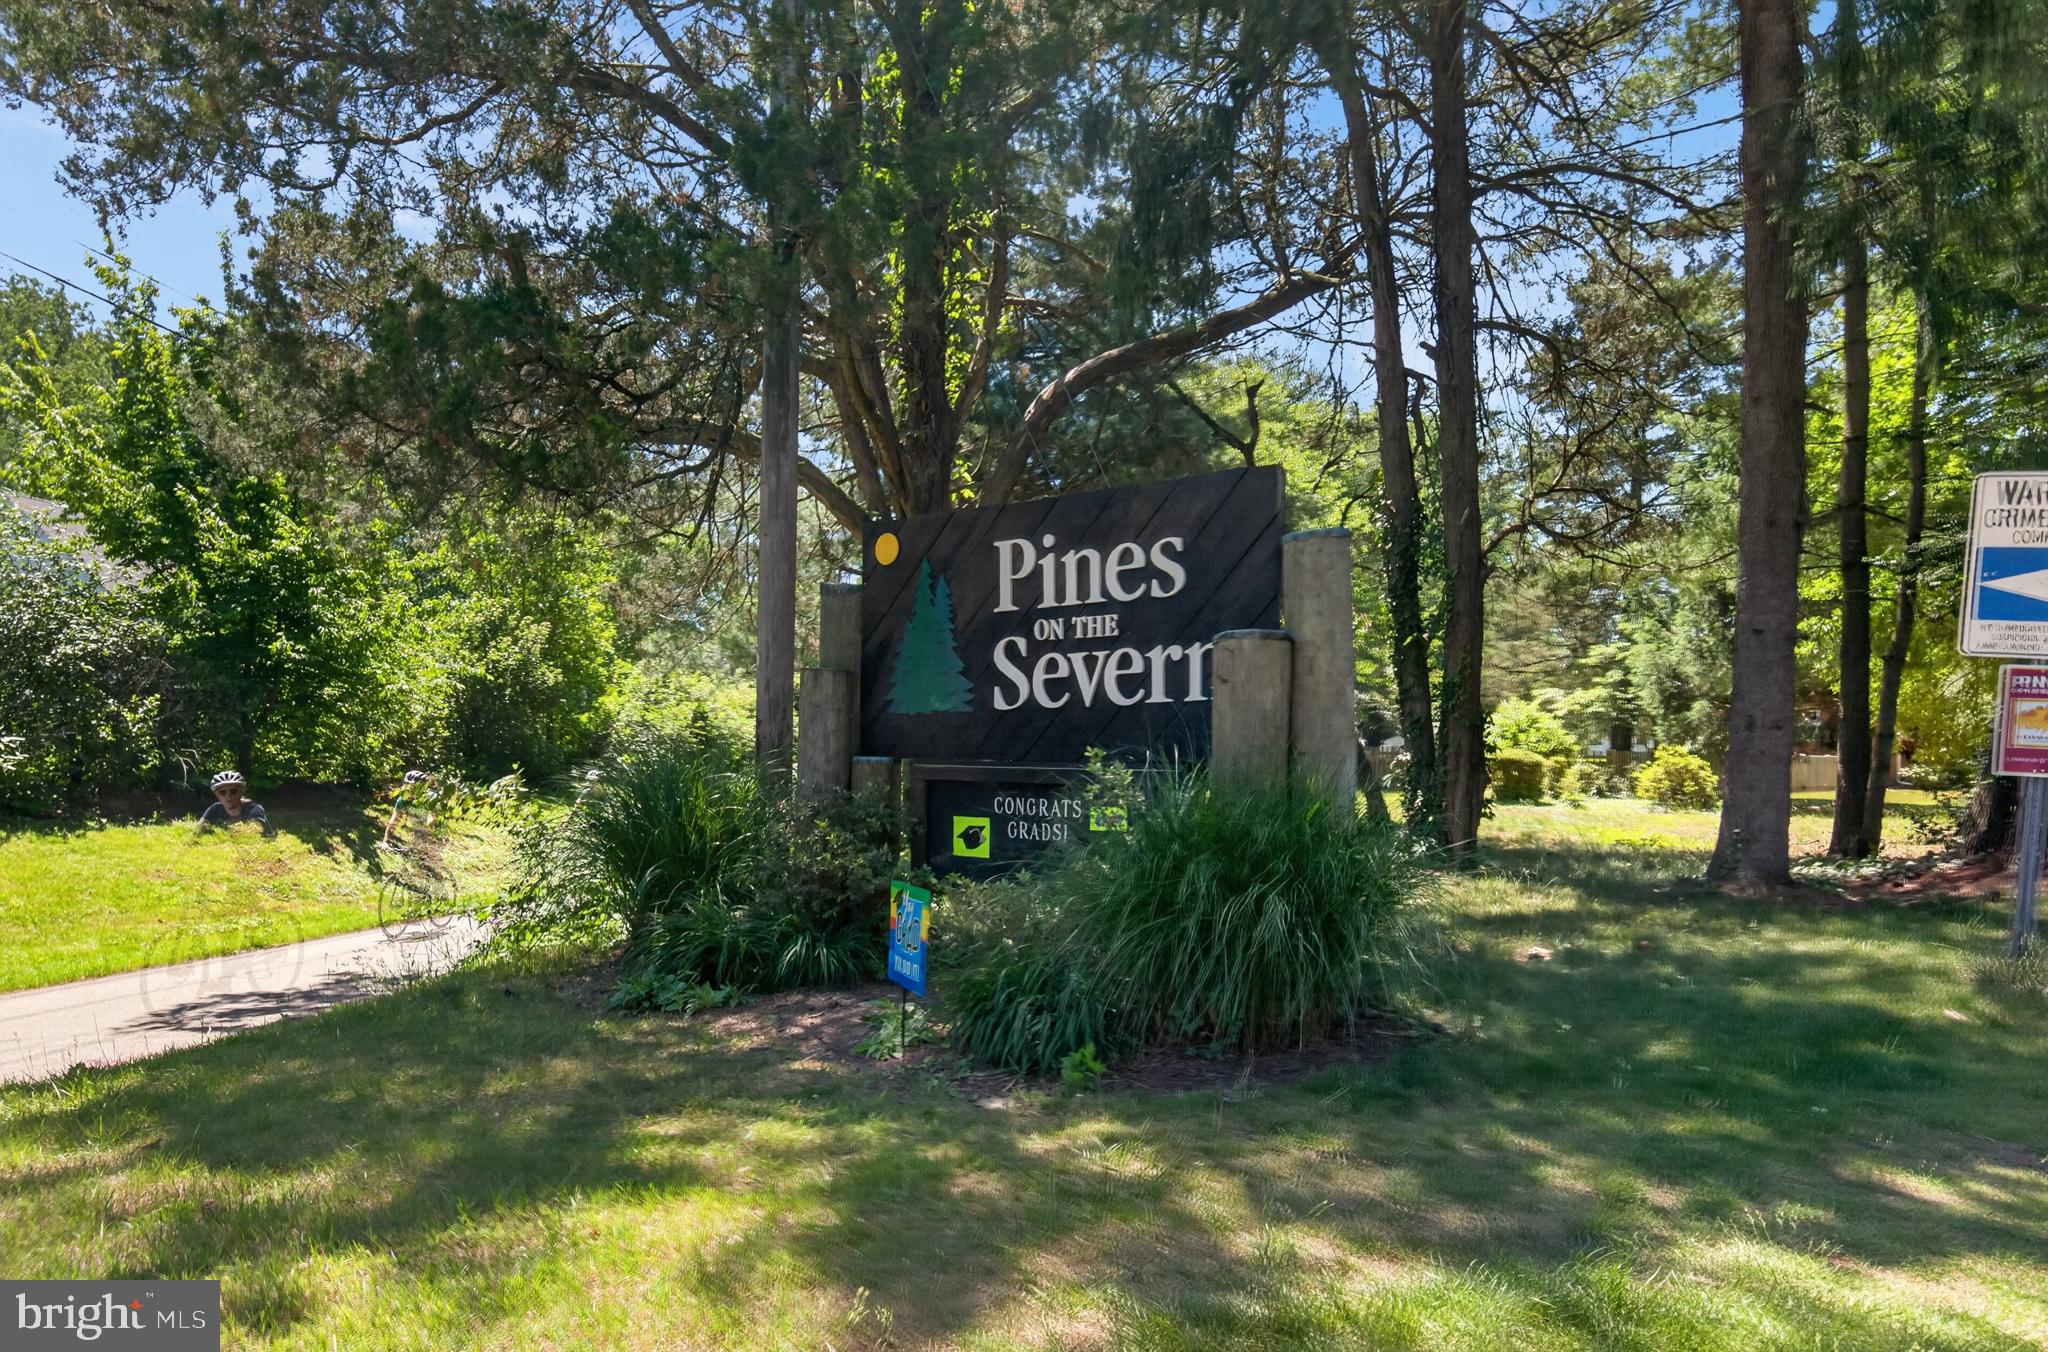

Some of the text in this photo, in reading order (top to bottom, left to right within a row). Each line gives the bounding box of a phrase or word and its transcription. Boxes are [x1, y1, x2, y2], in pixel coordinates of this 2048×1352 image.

[993, 533, 1187, 613] Pines
[1033, 614, 1120, 641] ON THE
[994, 796, 1082, 819] CONGRATS
[1008, 821, 1069, 842] GRADS!
